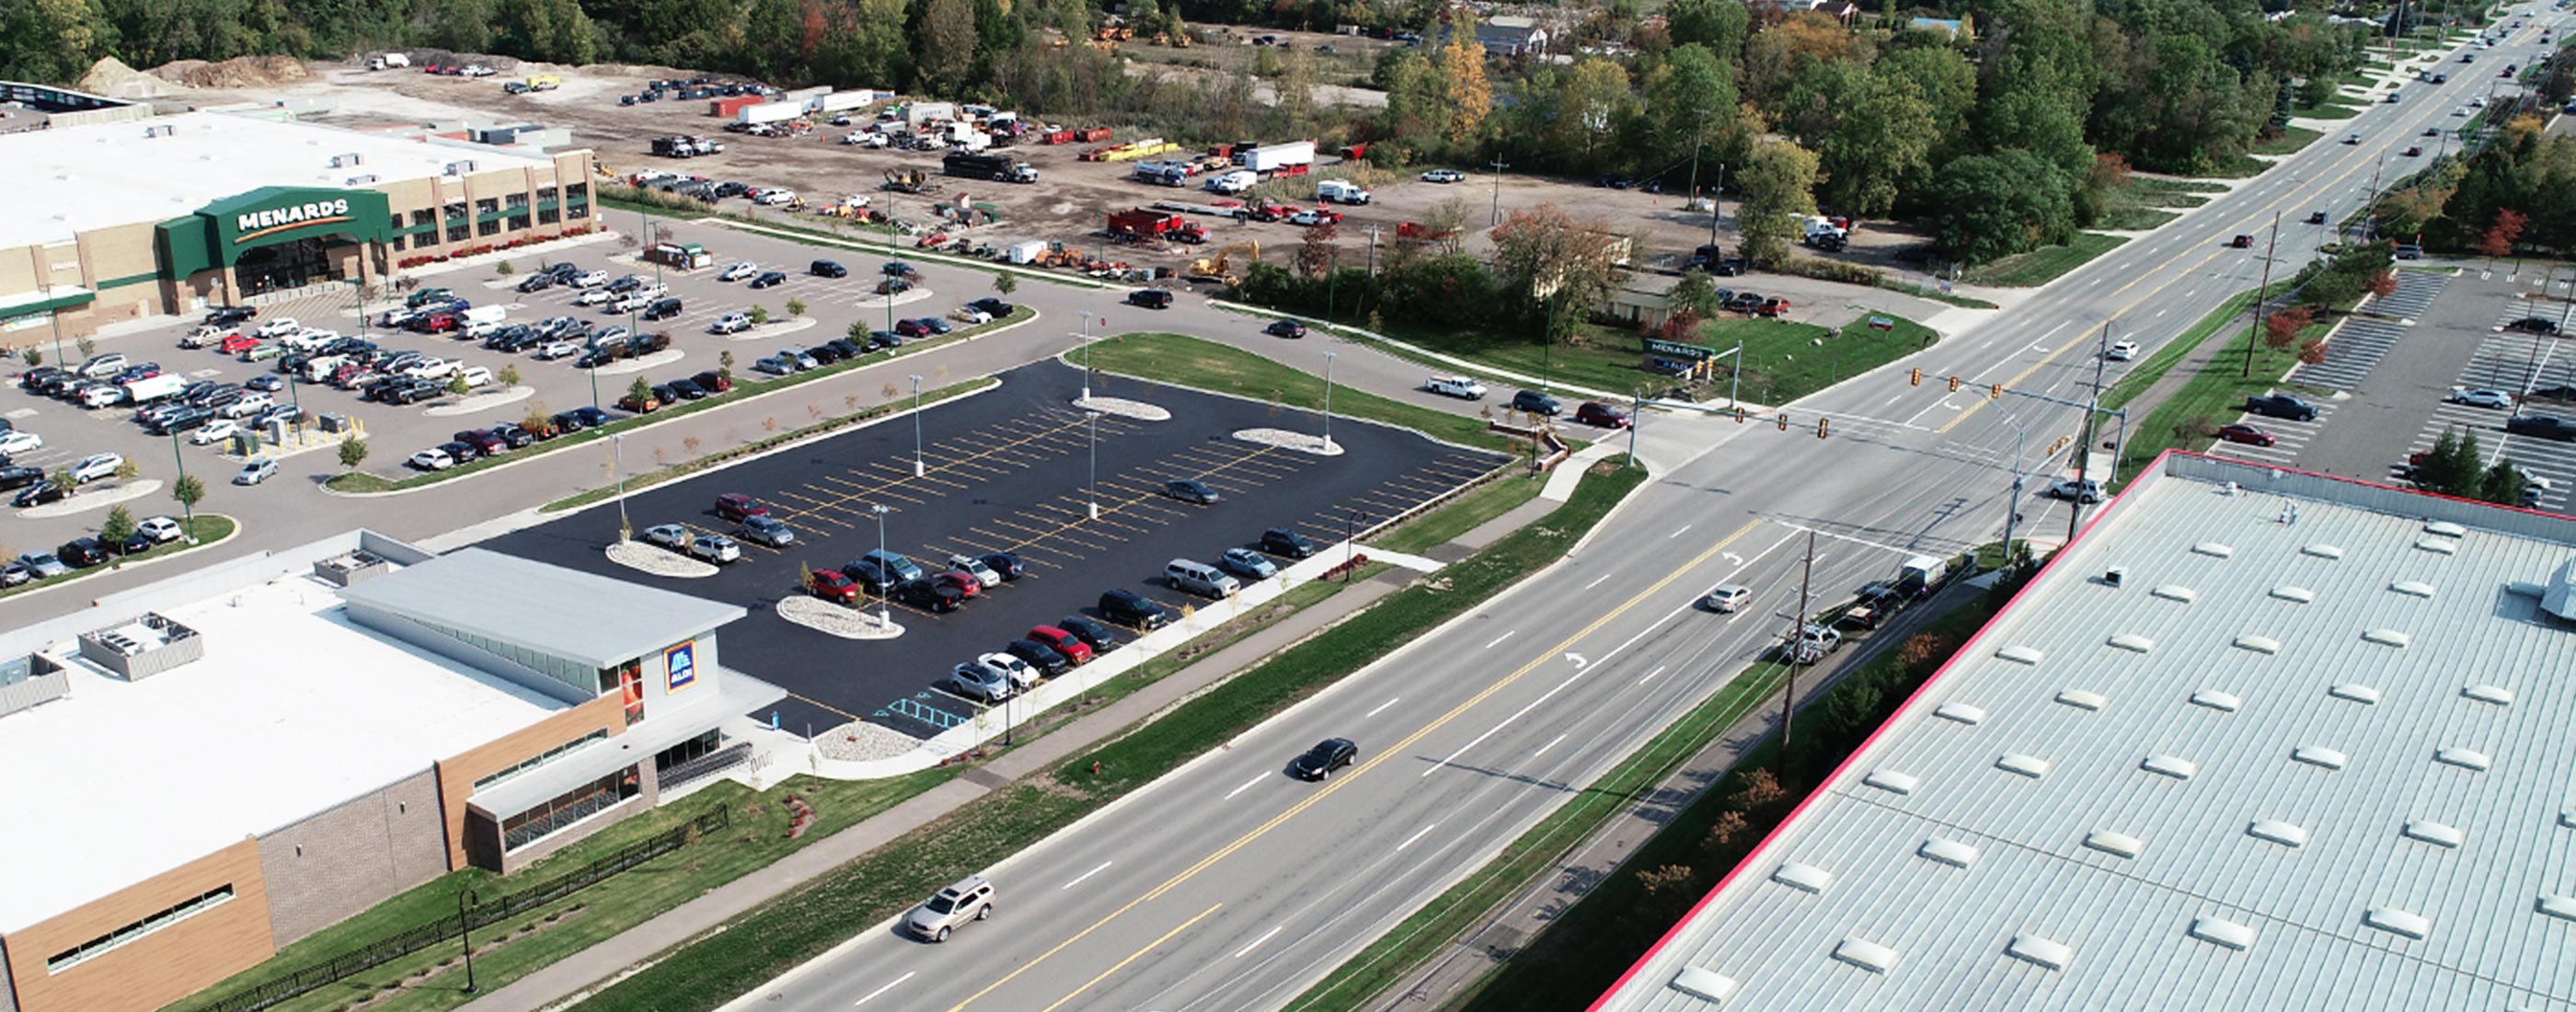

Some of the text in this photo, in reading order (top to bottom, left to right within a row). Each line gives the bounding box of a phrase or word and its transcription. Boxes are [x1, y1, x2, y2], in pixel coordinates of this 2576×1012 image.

[238, 199, 349, 231] MENARDS
[1651, 343, 1703, 357] MENARDS
[671, 668, 693, 684] ALDI
